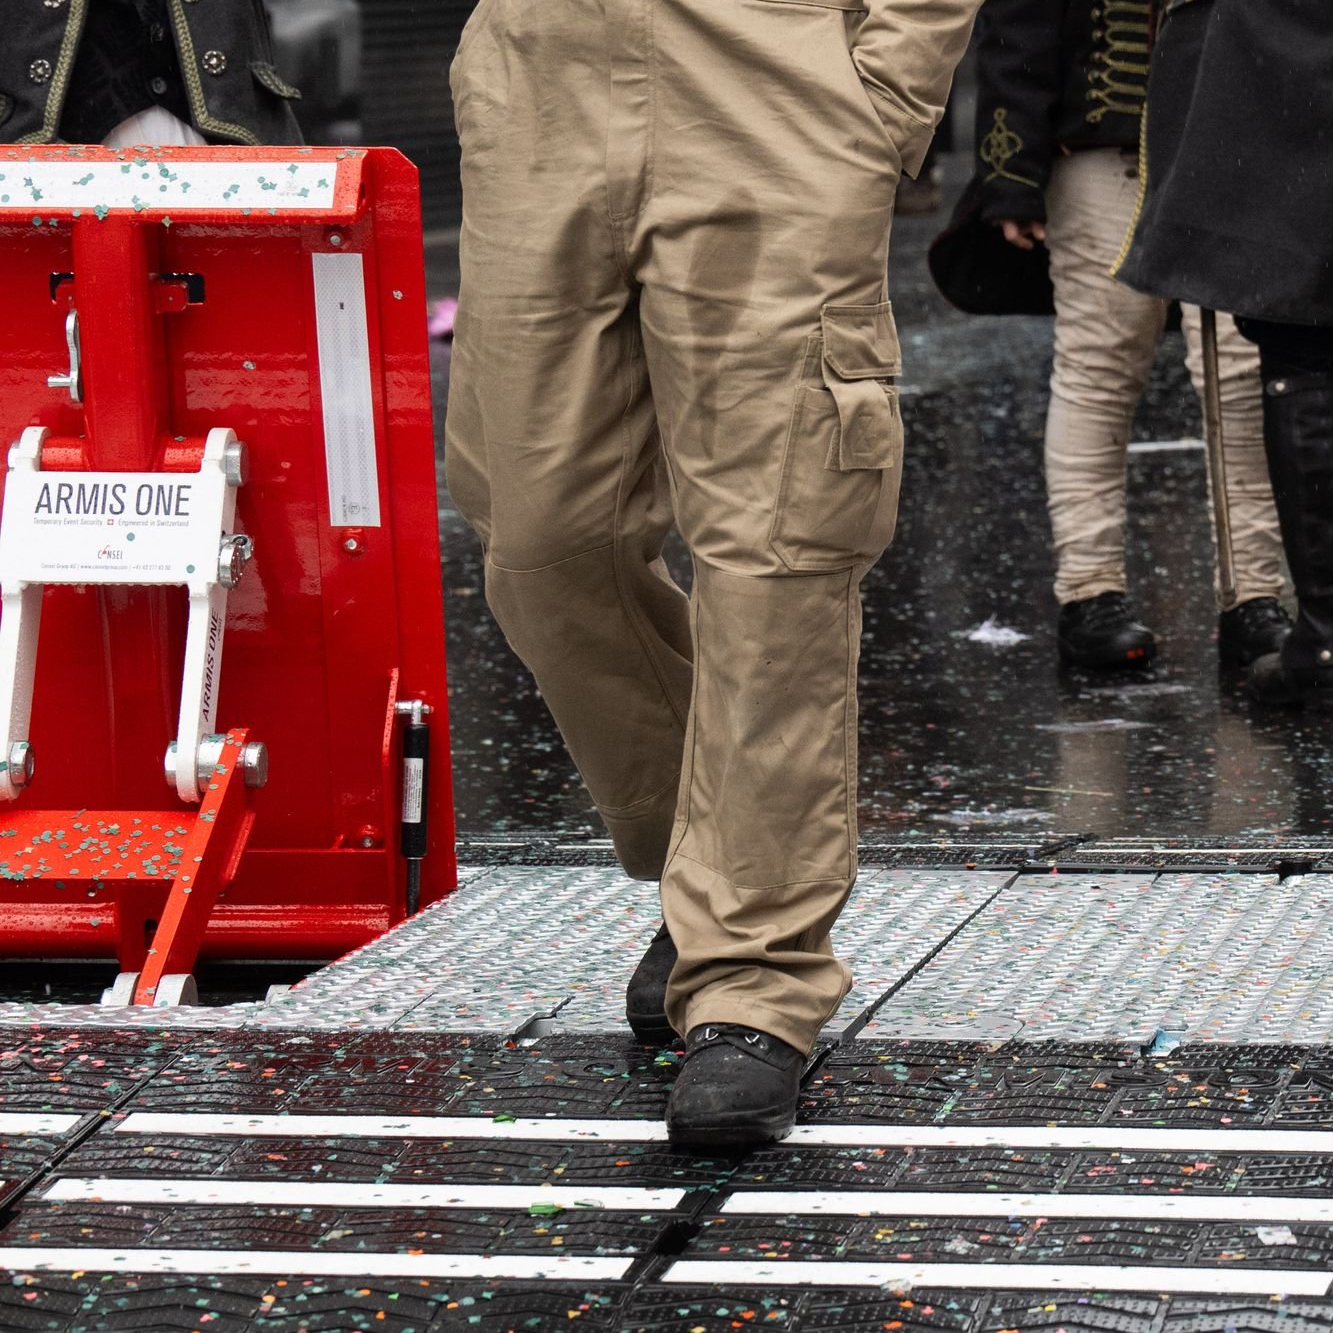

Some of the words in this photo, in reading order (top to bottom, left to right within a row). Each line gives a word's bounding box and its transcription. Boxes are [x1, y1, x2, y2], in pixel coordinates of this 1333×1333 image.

[34, 482, 127, 515] ARMIS
[135, 483, 192, 516] ONE
[208, 610, 219, 649] ONE
[202, 653, 216, 723] ARMIS
